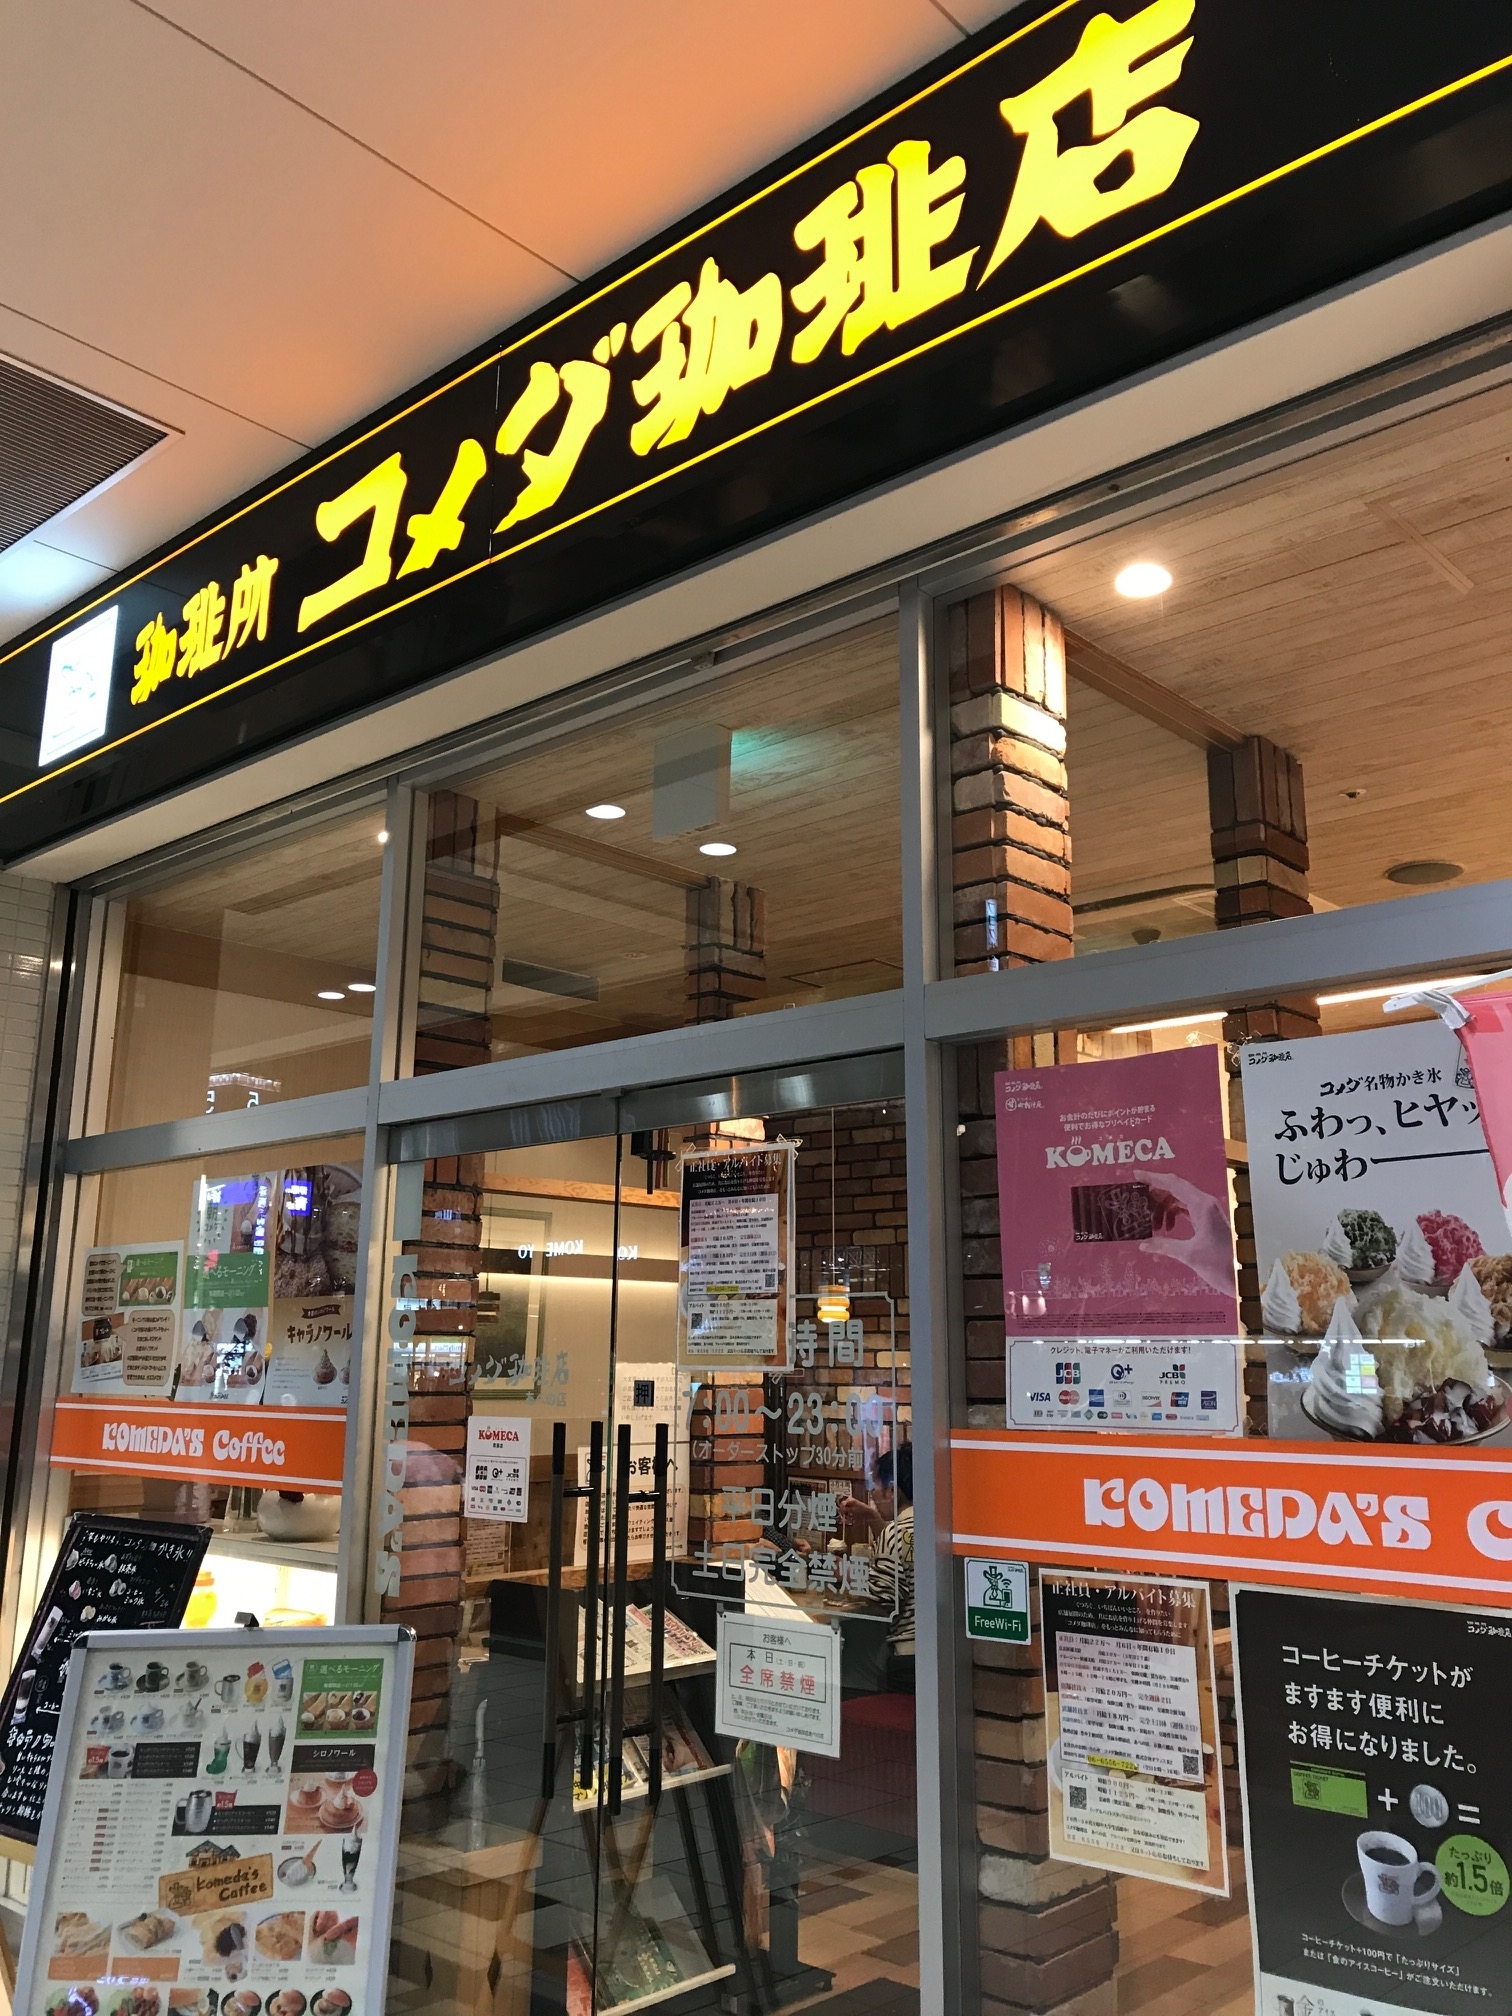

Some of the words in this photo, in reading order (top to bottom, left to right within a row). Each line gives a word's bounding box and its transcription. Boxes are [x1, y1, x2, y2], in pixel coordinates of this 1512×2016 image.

[131, 555, 280, 706] 珈琲所
[297, 0, 1200, 635] コメダ珈琲店
[1320, 1068, 1443, 1097] コメダ名物かき氷
[635, 1383, 650, 1405] 押
[1030, 1392, 1051, 1402] VISA
[102, 1422, 205, 1459] KOMEDA'S
[212, 1430, 286, 1466] Coffee
[720, 1485, 838, 1533] 平日分煙
[1083, 1478, 1433, 1551] KOMEDA'S
[692, 1539, 872, 1596] 土日完全禁煙
[762, 1633, 792, 1646] お客様へ
[740, 1664, 815, 1696] 全席禁煙
[1282, 1645, 1474, 1689] コーヒーチケットが
[1285, 1681, 1445, 1726] ますます便利に
[1288, 1720, 1478, 1775] お得になりました。
[1449, 1846, 1492, 1866] たっぷり
